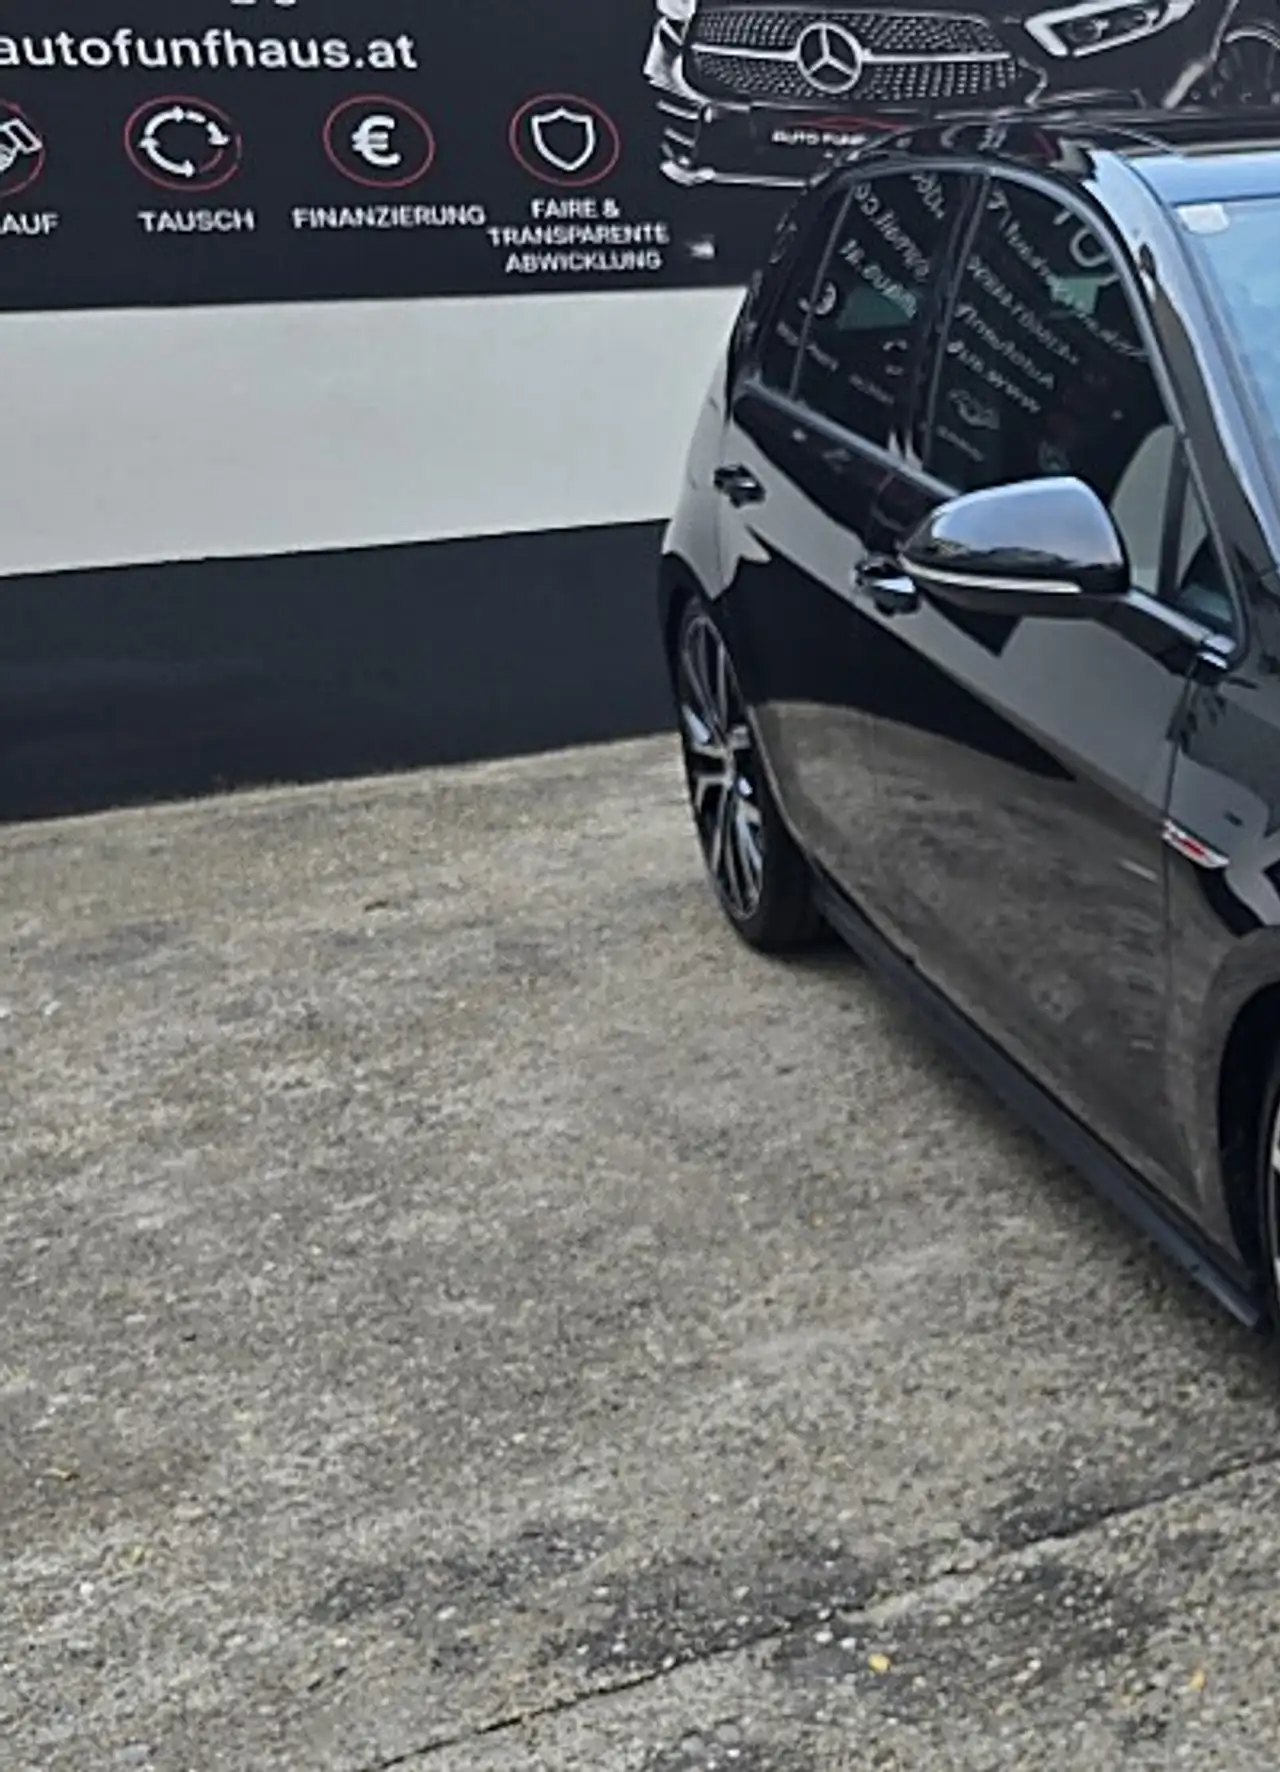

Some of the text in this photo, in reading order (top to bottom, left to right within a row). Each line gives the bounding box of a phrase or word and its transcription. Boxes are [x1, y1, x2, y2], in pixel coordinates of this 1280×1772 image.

[137, 207, 255, 233] TAUSCH
[292, 204, 487, 229] FINANZIERUNG
[531, 198, 621, 220] FAIRE &
[0, 211, 60, 236] AUF
[487, 223, 670, 247] TRANSPARENTE
[504, 248, 663, 274] ABWICKLUNG
